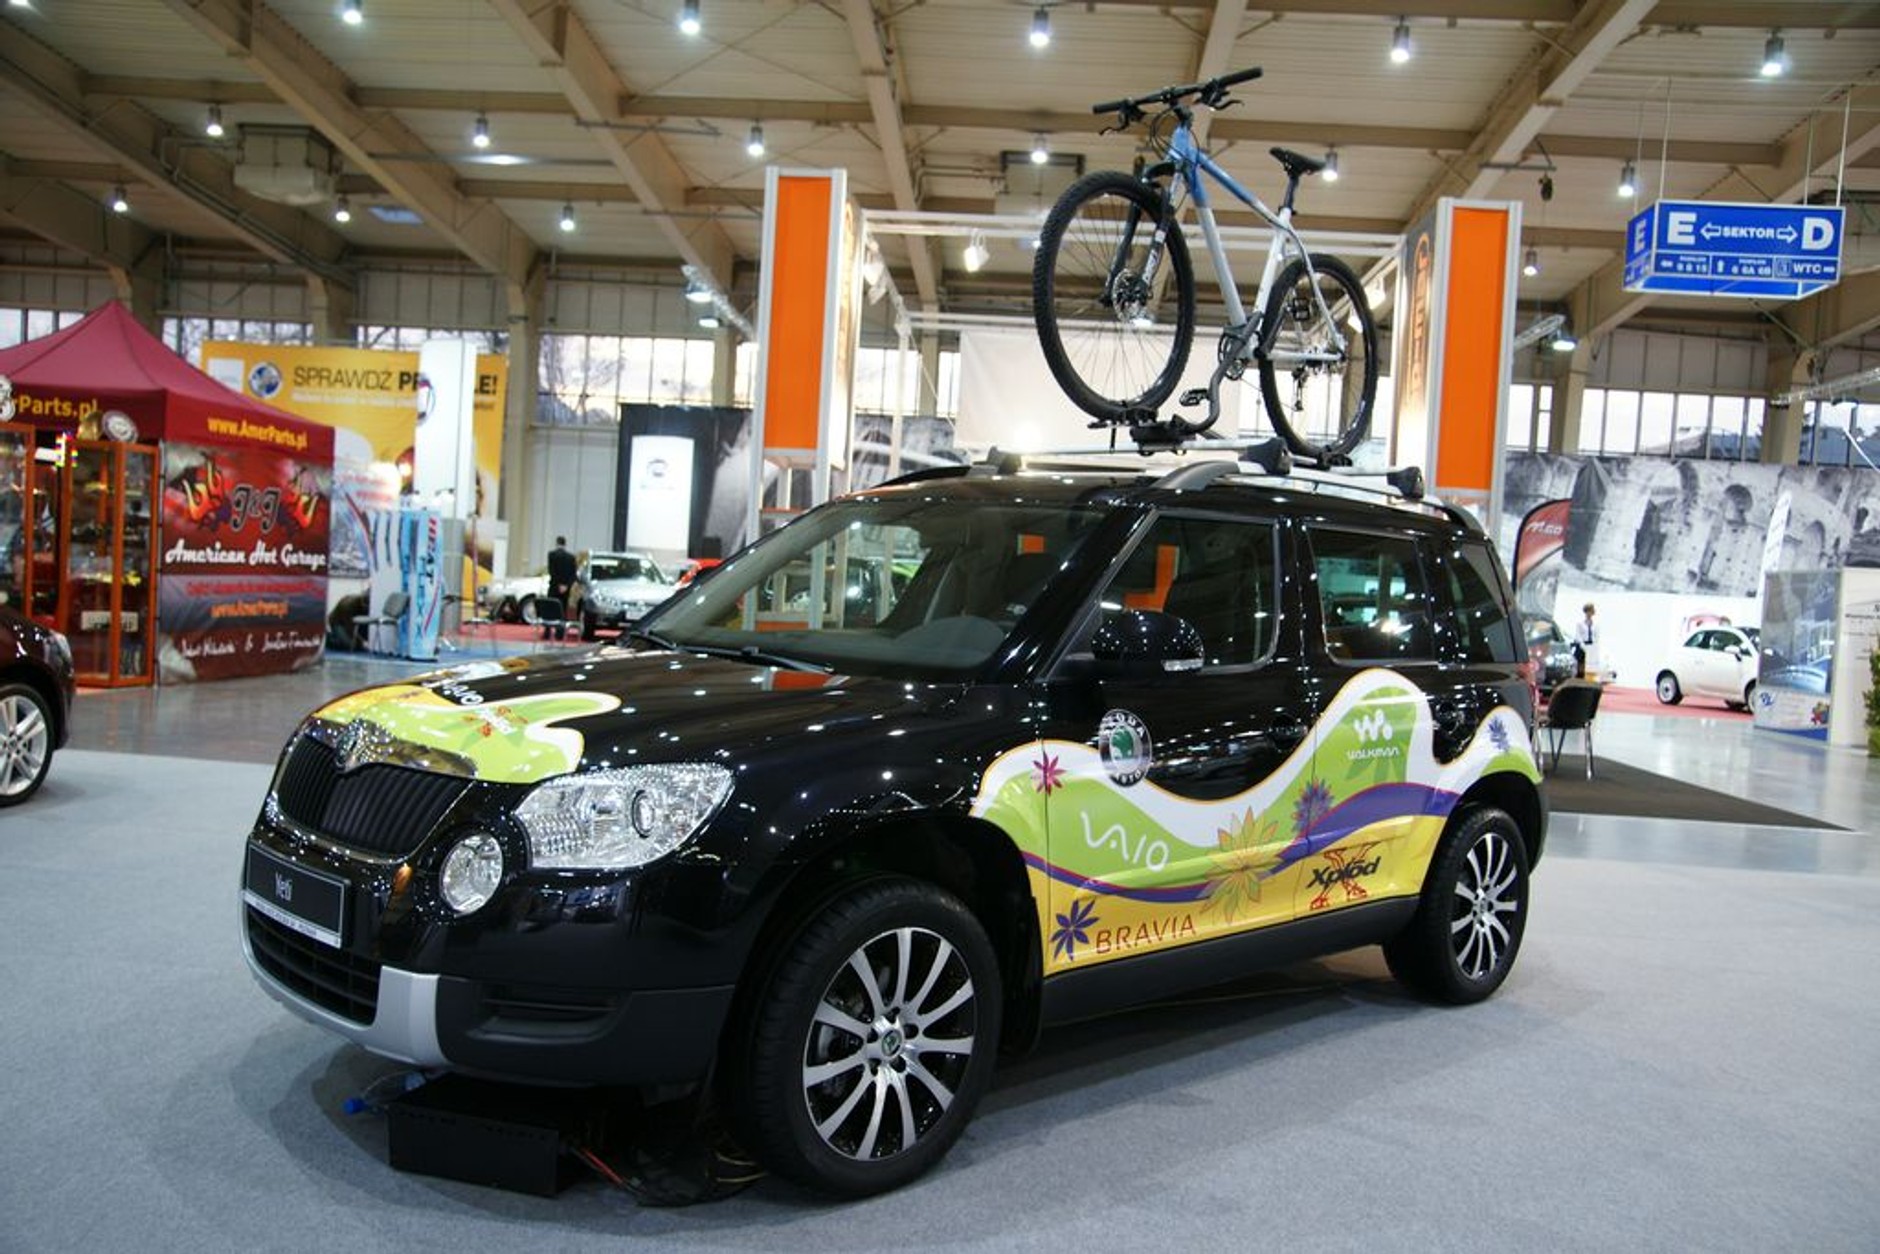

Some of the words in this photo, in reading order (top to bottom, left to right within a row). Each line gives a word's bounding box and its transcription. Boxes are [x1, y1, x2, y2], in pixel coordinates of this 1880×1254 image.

[1667, 212, 1697, 245] E
[1723, 227, 1775, 240] SEKTOR
[1801, 217, 1835, 250] D
[1793, 263, 1822, 274] WTC
[207, 417, 308, 449] www.AmerParts.pl
[165, 538, 246, 564] American
[248, 539, 278, 566] Hot
[280, 543, 326, 571] Garage
[1080, 810, 1170, 872] VAIO
[1095, 913, 1197, 954] BRAVIA
